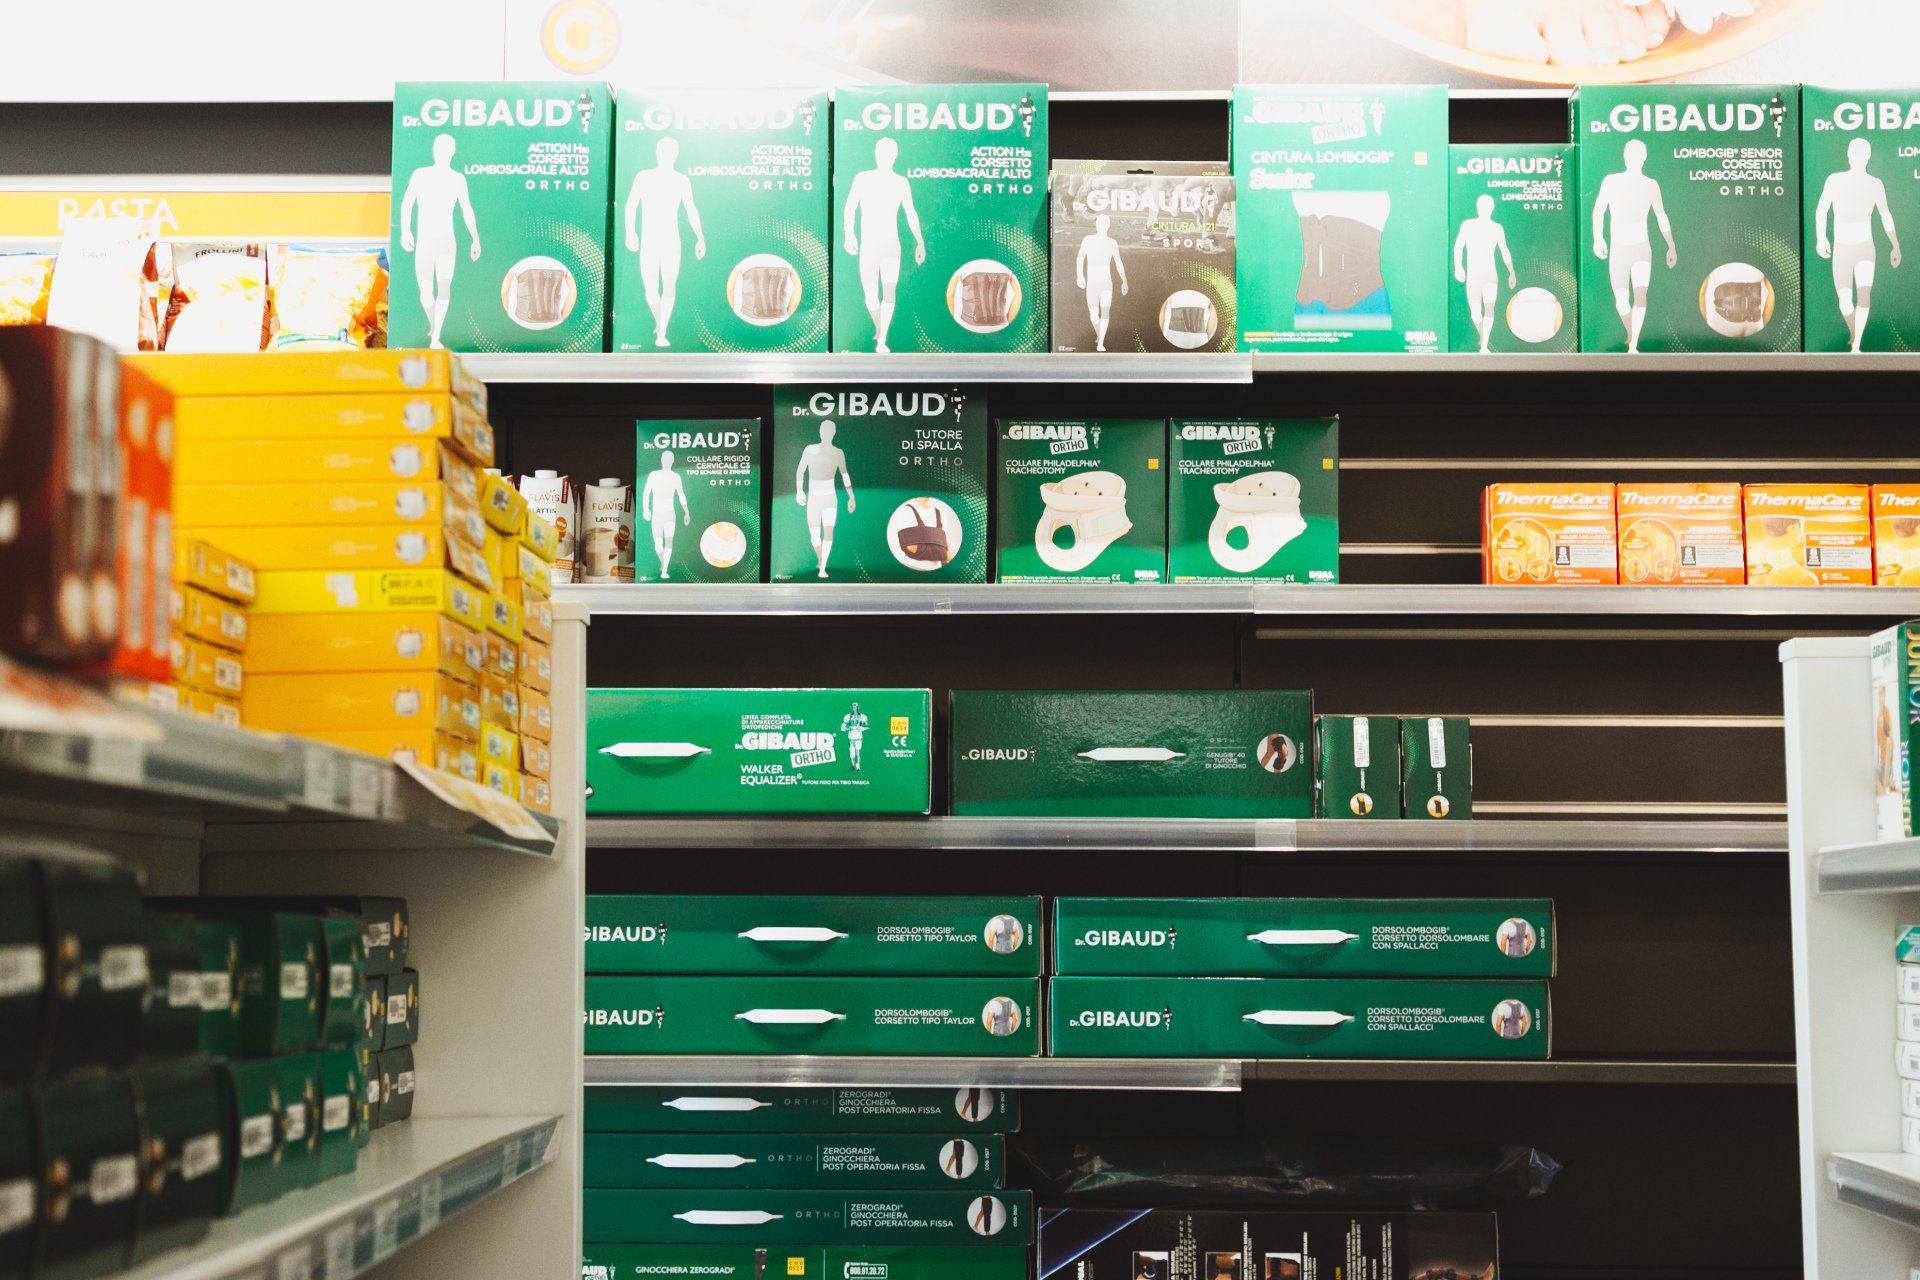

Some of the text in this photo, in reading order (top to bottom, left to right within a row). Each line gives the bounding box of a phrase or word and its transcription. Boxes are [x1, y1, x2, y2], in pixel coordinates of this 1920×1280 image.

[528, 143, 571, 153] ACTION
[751, 145, 794, 155] ACTION
[970, 147, 1014, 156] ACTION
[1740, 148, 1782, 158] SENIOR
[528, 154, 589, 164] CORSETTO
[751, 156, 811, 166] CORSETTO
[971, 157, 1031, 168] CORSETTO
[1251, 151, 1313, 164] CINTURA
[1722, 159, 1782, 169] CORSETTO
[464, 164, 589, 175] LOMBOSACRALE ALTO
[688, 166, 811, 176] LOMBOSACRALE ALTO
[907, 168, 1031, 179] LOMBOSACRALE ALTO
[1250, 167, 1315, 190] Senior
[1689, 170, 1783, 181] LOMBOSACRALE
[525, 180, 590, 190] ORTHO
[749, 180, 813, 190] ORTHO
[968, 184, 1033, 194] ORTHO
[1720, 186, 1784, 196] ORTHO
[1501, 193, 1562, 201] LOMBOSACRALE
[1152, 222, 1195, 231] CINTURA
[1162, 238, 1214, 248] SPORT
[915, 430, 962, 440] TUTORE
[902, 440, 962, 451] DI SPALLA
[1052, 440, 1085, 453] ORTHO
[1226, 440, 1259, 453] ORTHO
[899, 456, 963, 466] ORTHO
[1005, 467, 1066, 475] TRACHEOTOMY
[1178, 467, 1240, 475] TRACHEOTOMY
[1496, 491, 1612, 505] ThermaCare
[1621, 491, 1737, 506] ThermaCare
[1750, 493, 1864, 506] ThermaCare
[592, 502, 623, 511] FLAVIS
[794, 750, 832, 766] ORTHO
[740, 765, 783, 774] WALKER
[1372, 934, 1490, 942] CORSETTO DORSOLOMBARE
[584, 1010, 654, 1026] IBAUD
[874, 1017, 975, 1025] CORSETTO TIPO TAYLOR
[1367, 1015, 1485, 1023] CORSETTO DORSOLOMBARE
[1367, 1023, 1434, 1031] CON SPALLACCI
[839, 1098, 896, 1106] GINOCCHIERA
[839, 1106, 942, 1114] POST OPERATORIA FISSA
[767, 1154, 813, 1162] ORTHO
[823, 1163, 925, 1171] POST OPERATORIA FISSA
[850, 1219, 953, 1227] POST OPERATORIA FISSA
[635, 1266, 688, 1274] GINOCCHIERA
